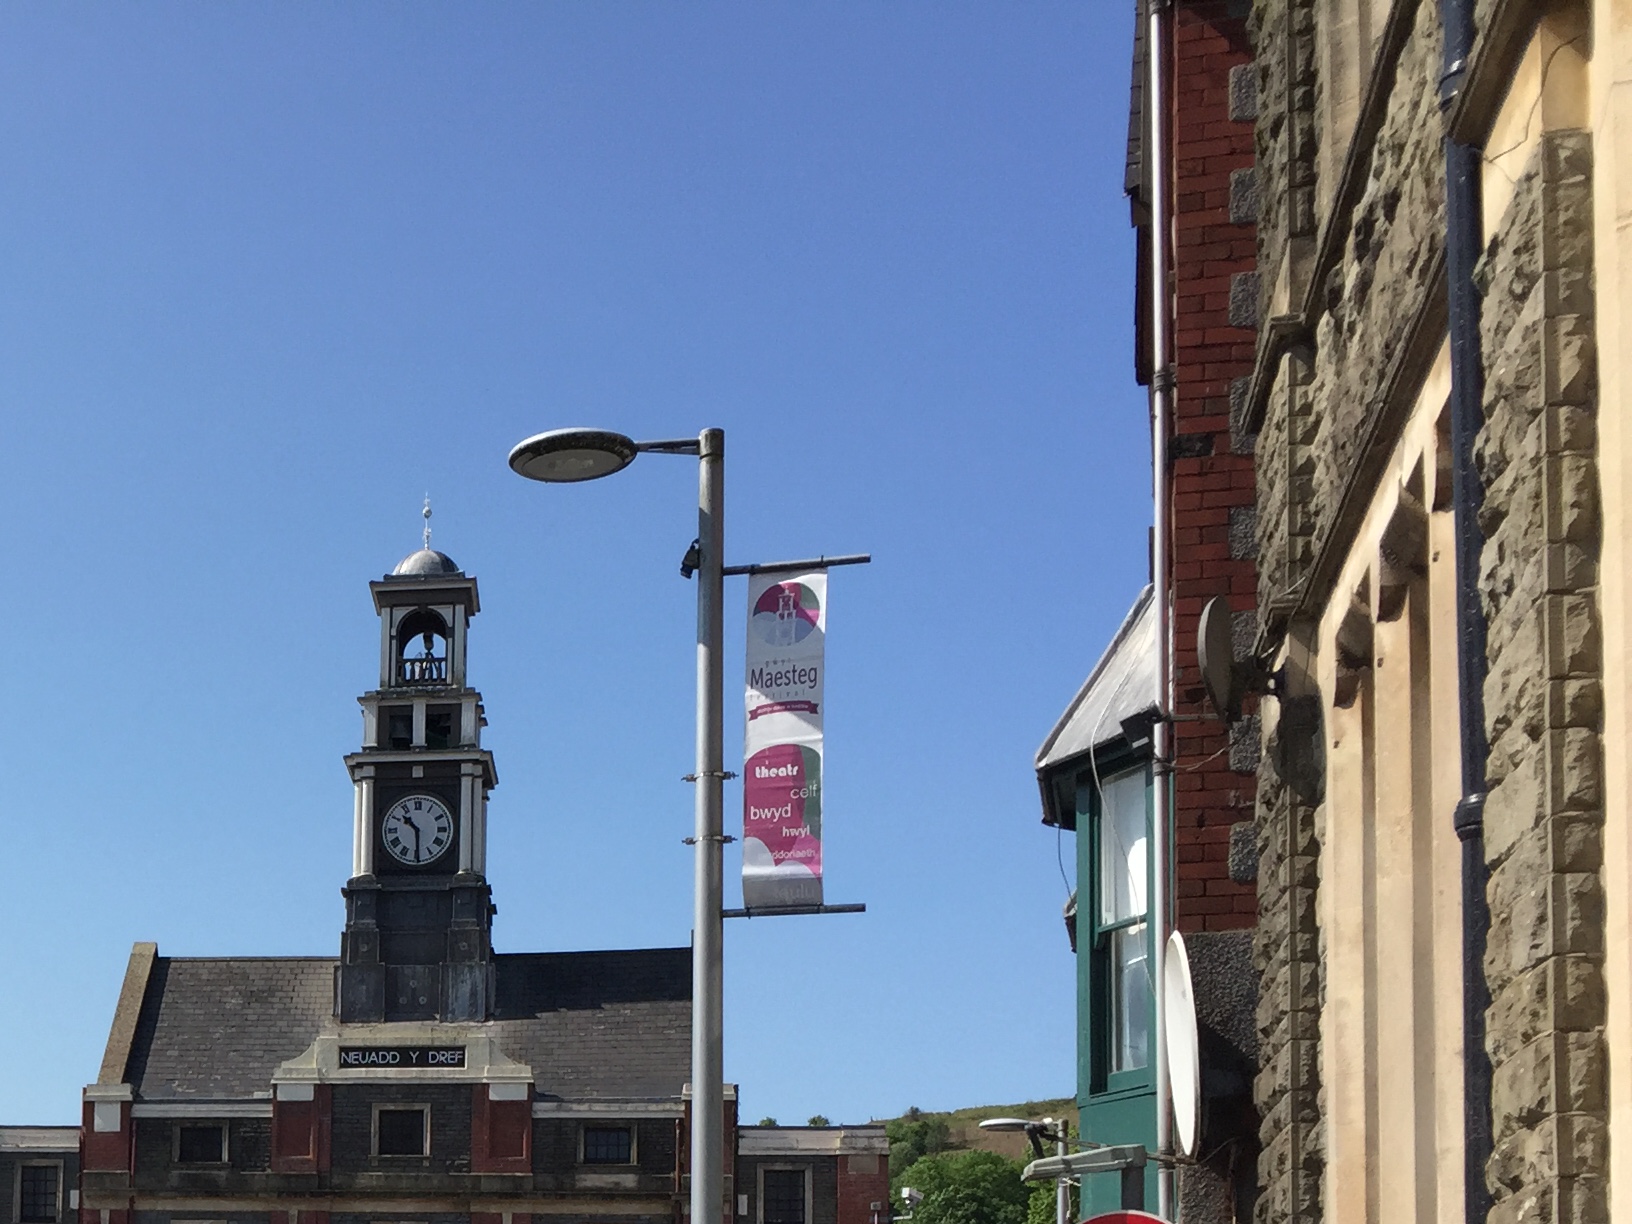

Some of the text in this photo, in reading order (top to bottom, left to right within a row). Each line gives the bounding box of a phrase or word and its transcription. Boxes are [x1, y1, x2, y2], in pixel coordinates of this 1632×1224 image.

[750, 664, 818, 689] Maesteg
[755, 764, 799, 778] theatr
[790, 783, 818, 799] celf
[750, 803, 792, 822] bwyd
[782, 824, 810, 838] hwyl
[340, 1051, 464, 1064] NEUADD Y DREF
